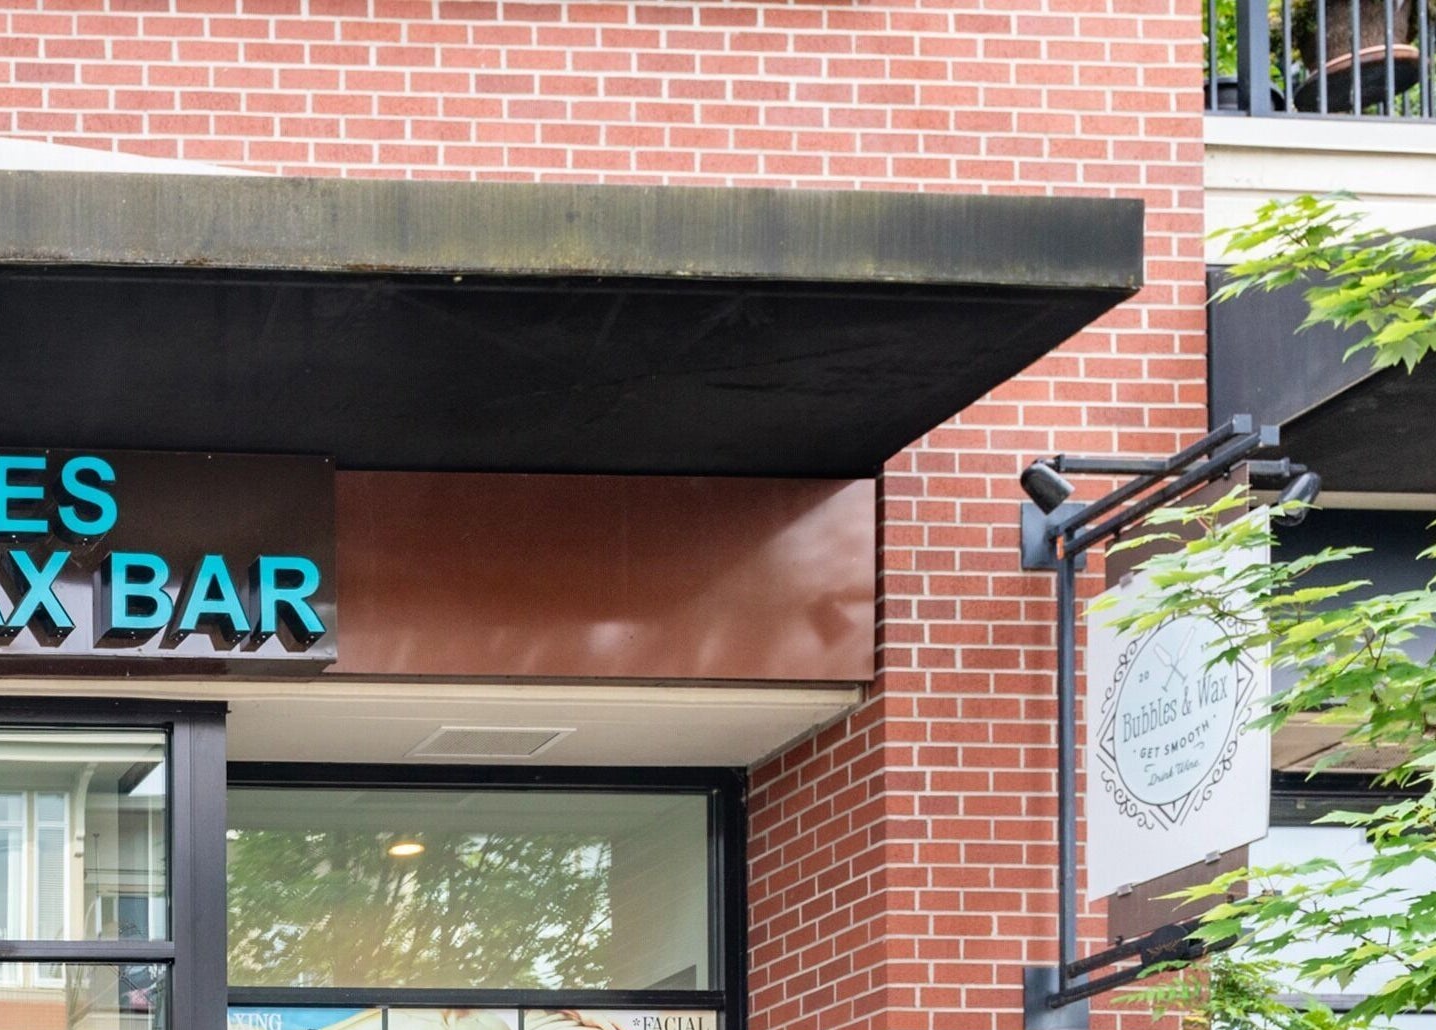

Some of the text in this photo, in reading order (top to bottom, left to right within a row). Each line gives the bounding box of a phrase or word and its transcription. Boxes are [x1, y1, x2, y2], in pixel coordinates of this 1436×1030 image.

[109, 552, 326, 635] BAR
[1122, 673, 1229, 744] Bubbles & Wax
[1140, 718, 1211, 760] GET SMOOTH
